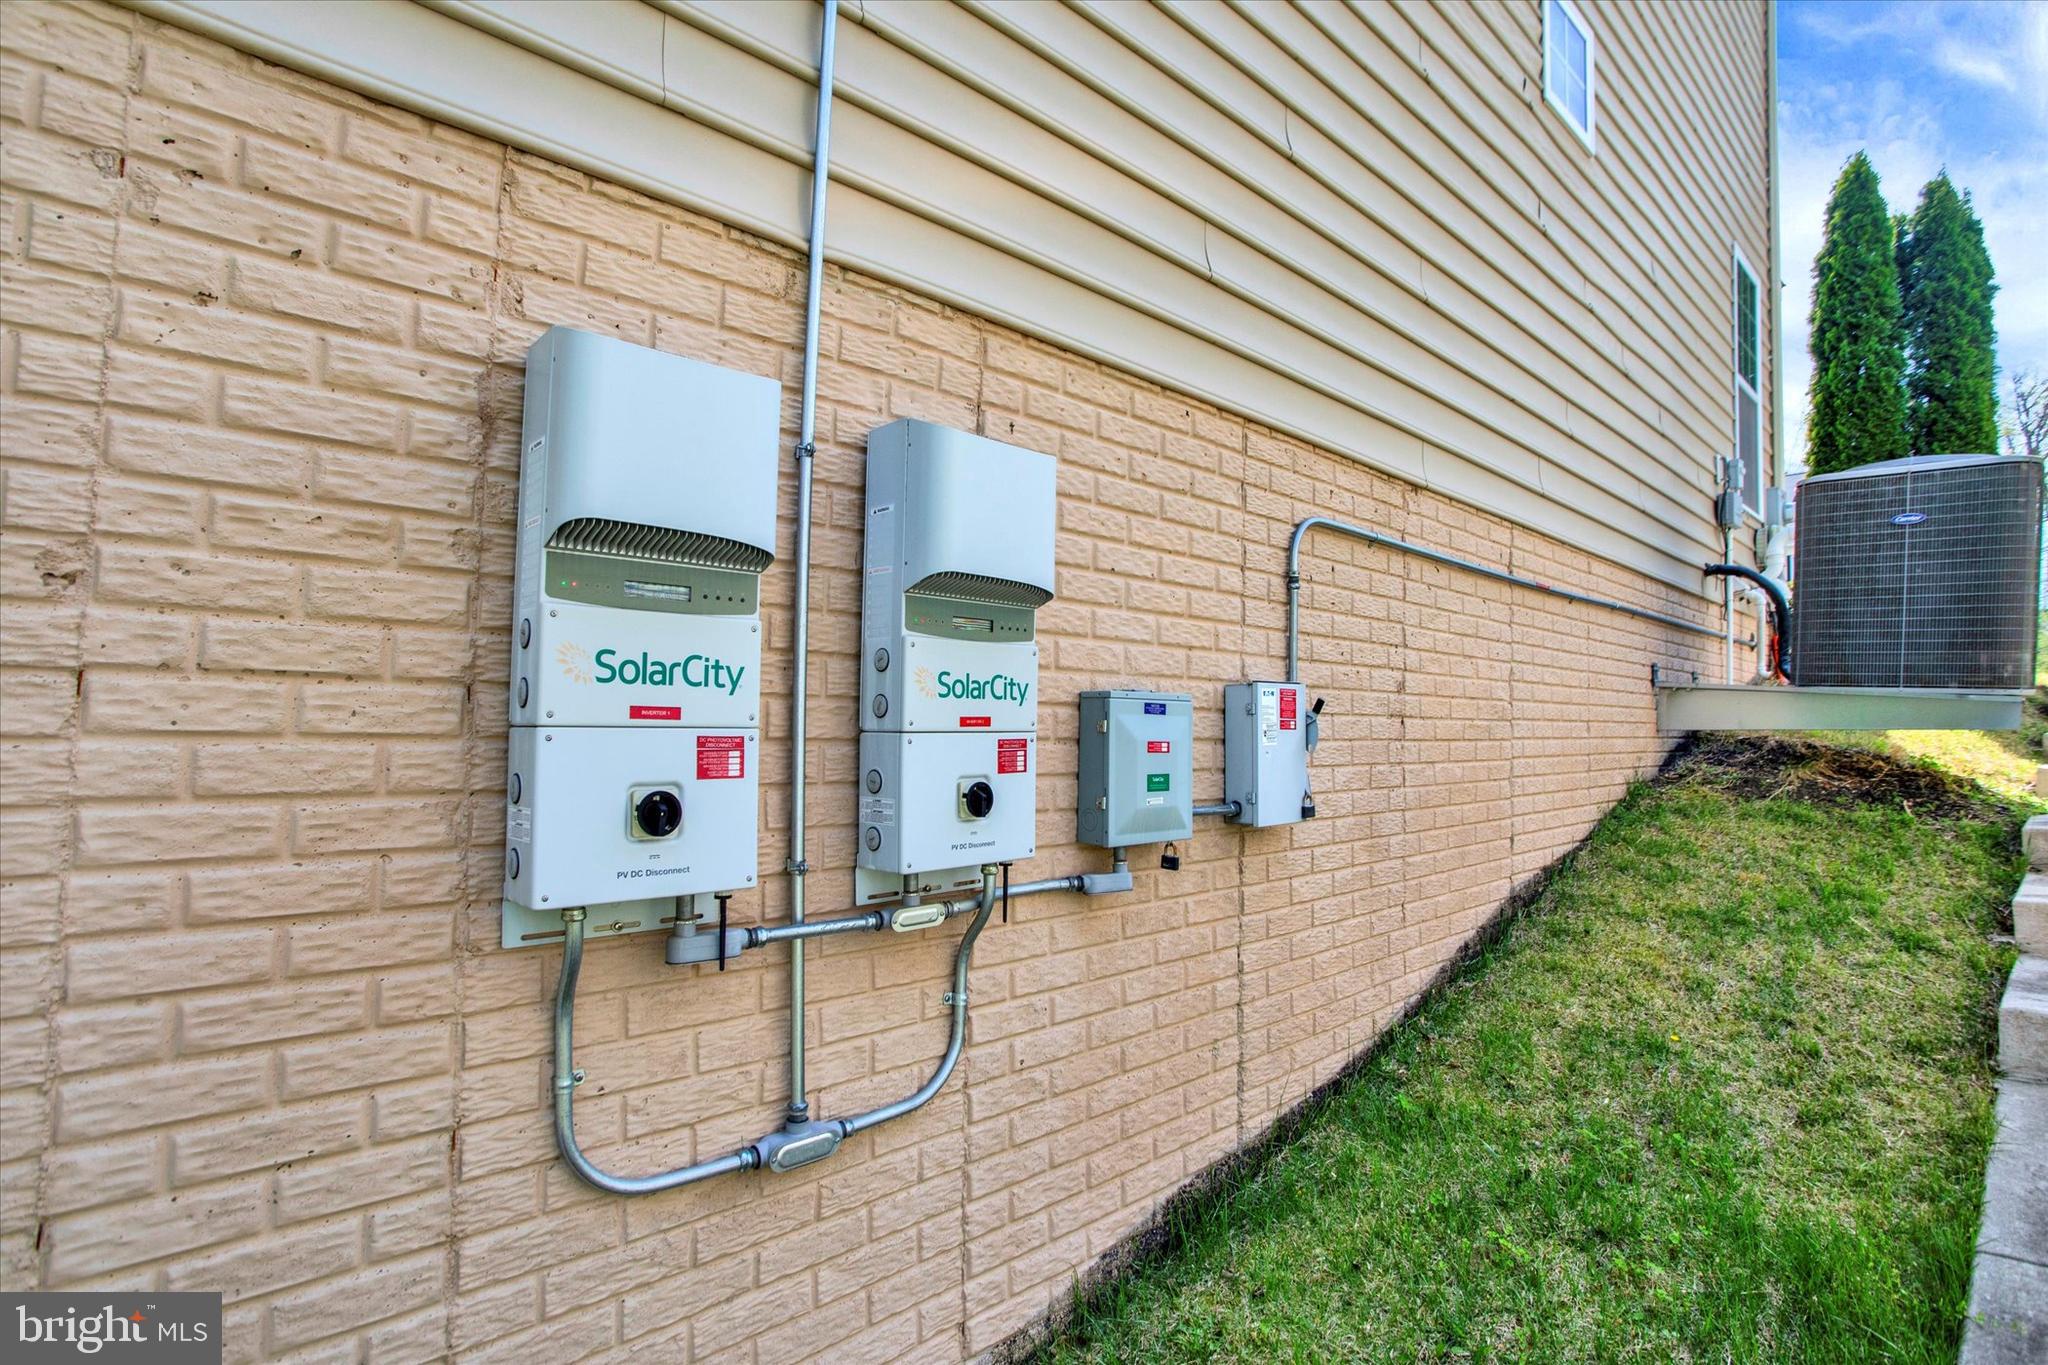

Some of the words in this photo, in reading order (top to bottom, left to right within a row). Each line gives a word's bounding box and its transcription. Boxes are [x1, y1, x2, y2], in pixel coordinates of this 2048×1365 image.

[595, 649, 745, 696] SolarCity
[937, 671, 1029, 707] SolarCity
[616, 871, 629, 879] PV
[630, 870, 643, 878] DC
[645, 866, 690, 877] Disconnect
